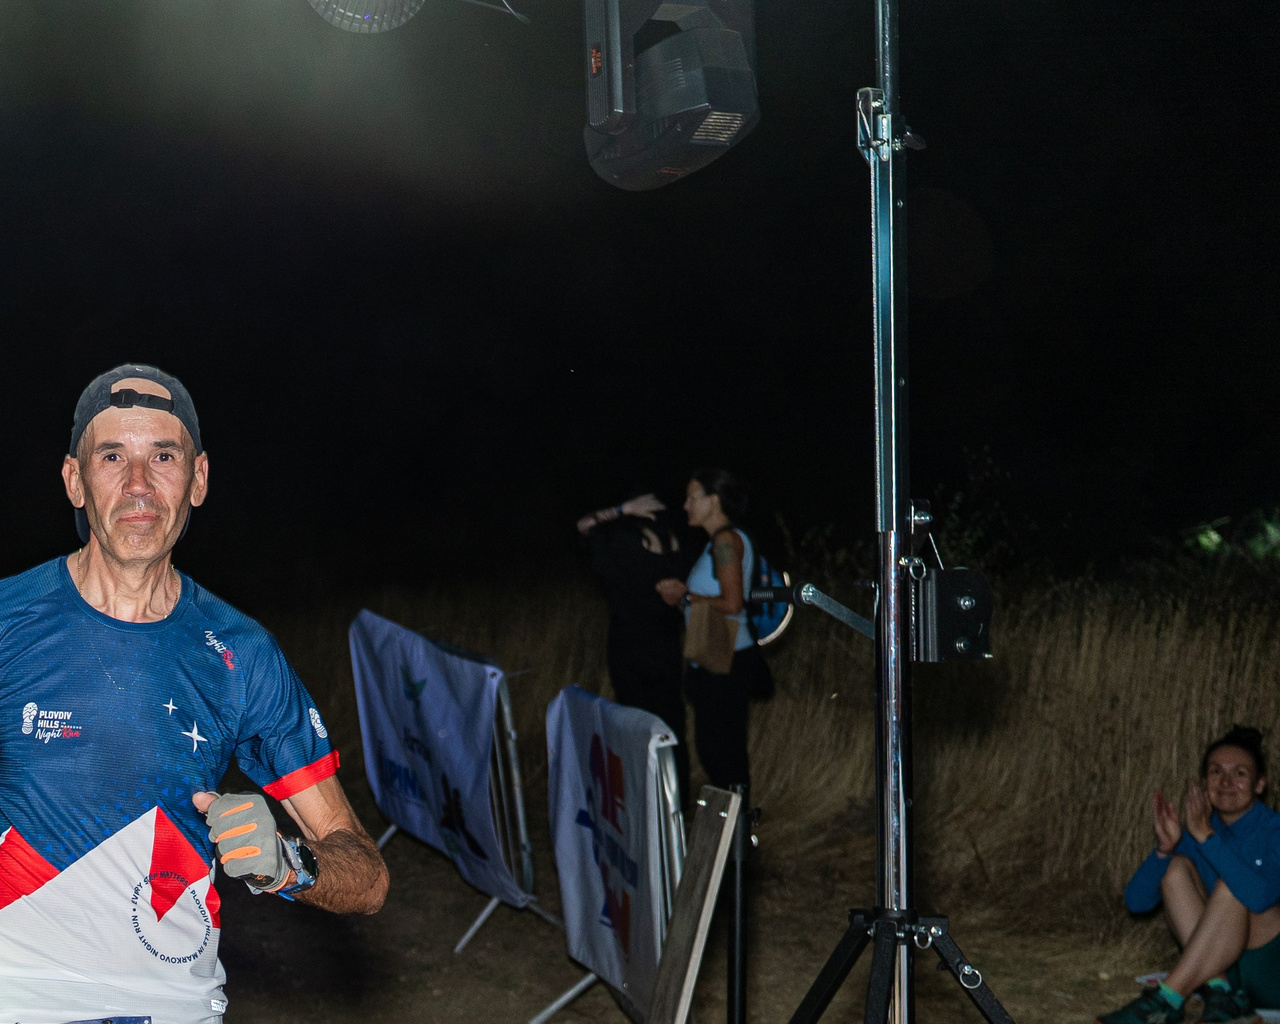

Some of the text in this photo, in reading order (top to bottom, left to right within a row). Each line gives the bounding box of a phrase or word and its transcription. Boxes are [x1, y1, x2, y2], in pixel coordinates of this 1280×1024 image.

[38, 710, 73, 720] PLOVDIV
[37, 719, 60, 729] HILLS
[35, 726, 81, 744] Night Run
[159, 870, 189, 887] MATTERS
[189, 889, 211, 924] PLOVDIV
[131, 915, 142, 934] RUN
[202, 925, 211, 947] HILLS
[138, 935, 159, 957] NIGHT
[197, 946, 205, 955] IN
[159, 951, 199, 964] MARKOVO
